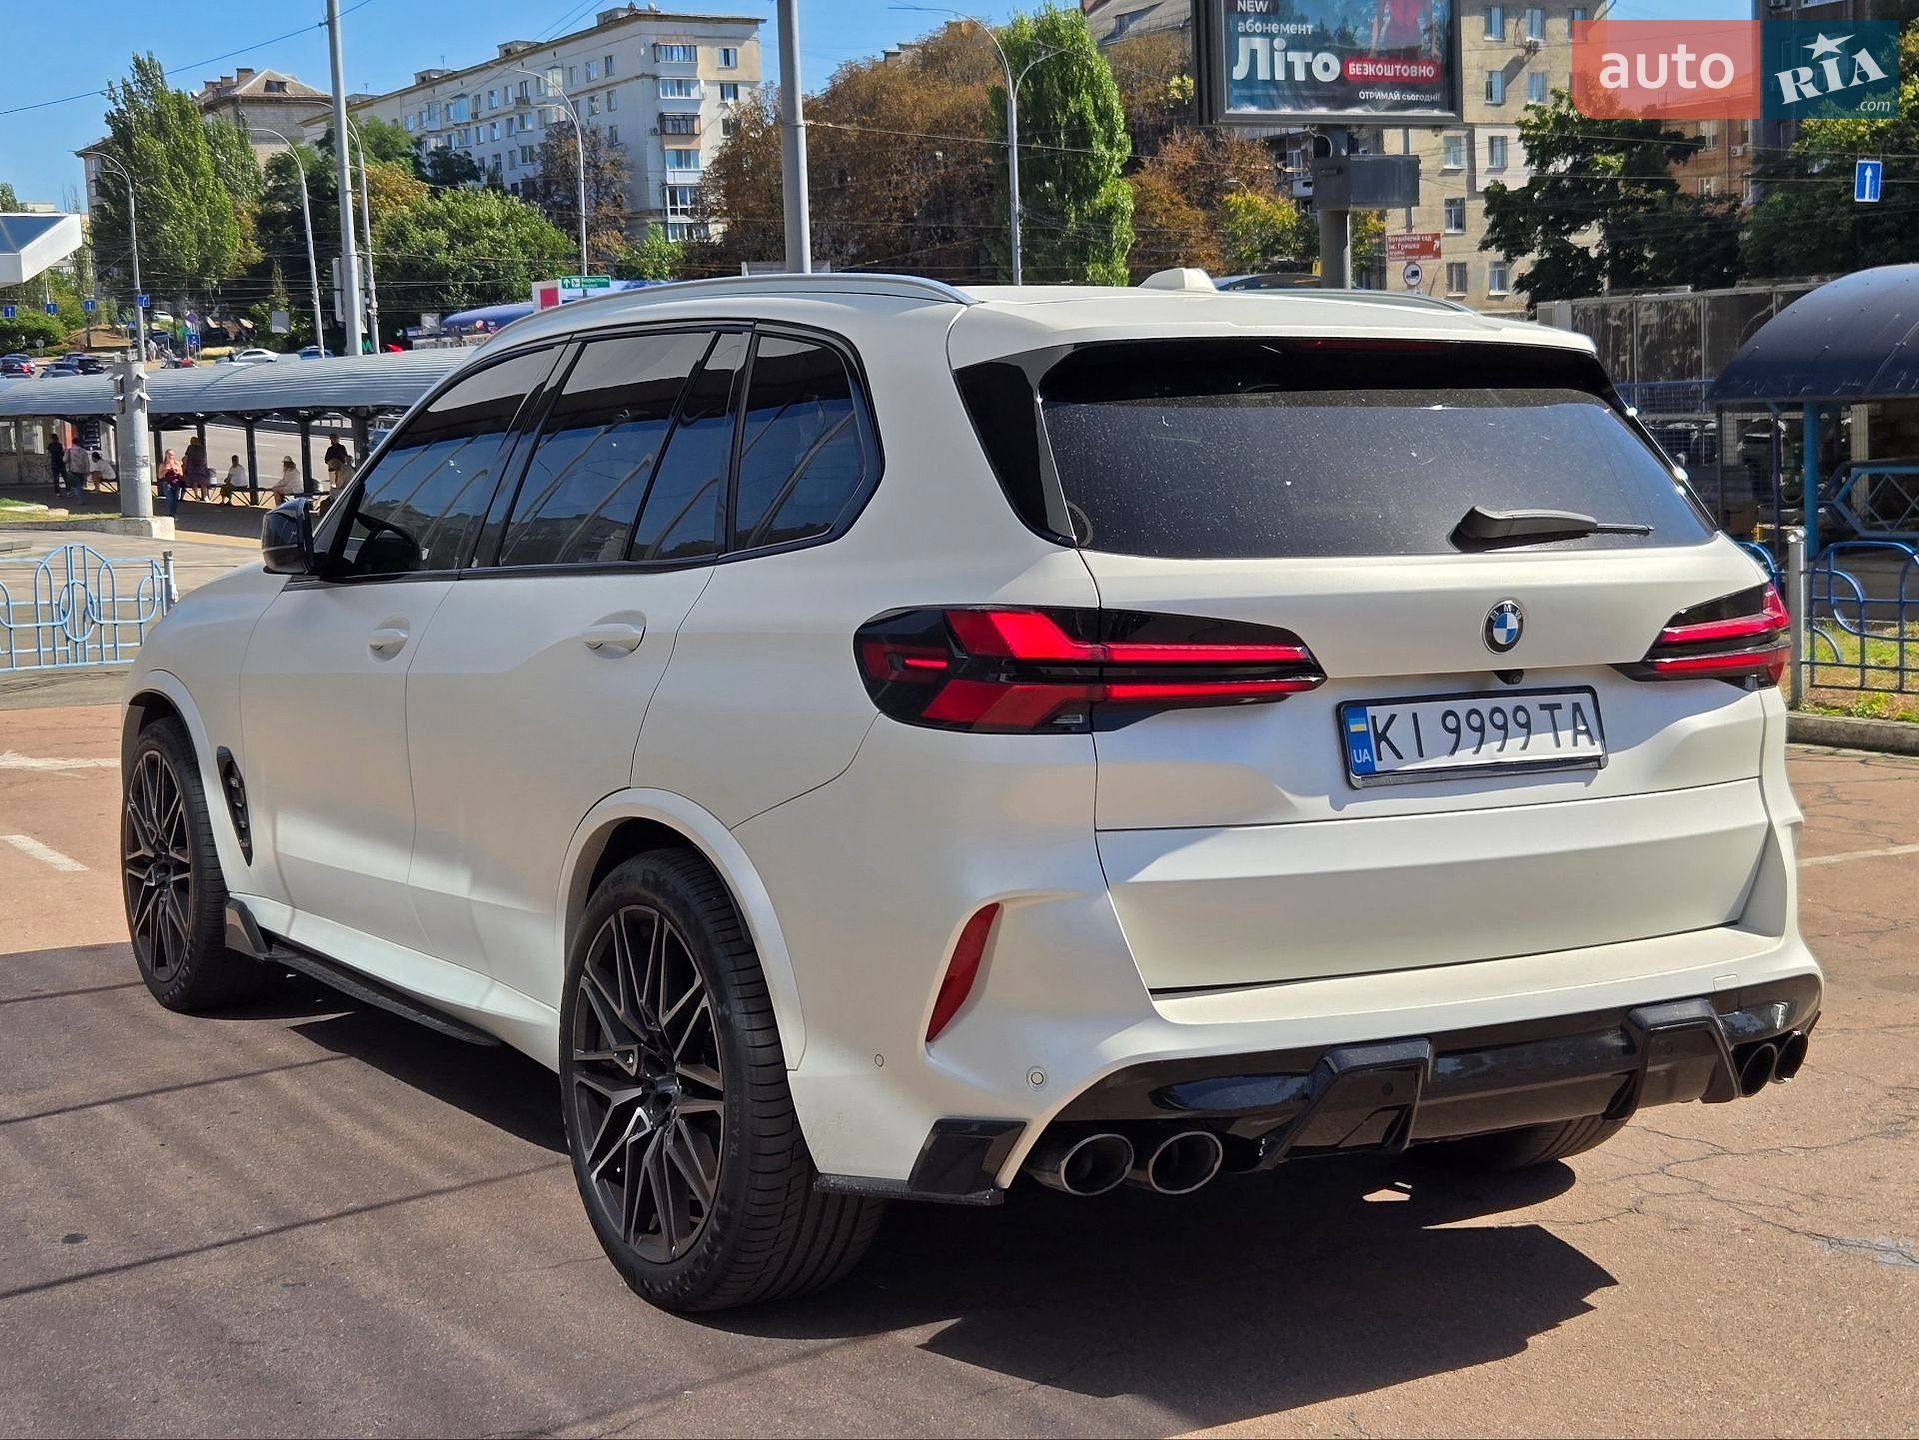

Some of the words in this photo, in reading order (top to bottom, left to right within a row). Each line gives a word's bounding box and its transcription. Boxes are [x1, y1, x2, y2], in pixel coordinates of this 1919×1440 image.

[1237, 0, 1268, 12] NEW
[1237, 19, 1313, 35] абонемент
[1232, 37, 1341, 82] Літо
[1348, 62, 1435, 78] БЕЗКОШТОВНО
[1358, 90, 1400, 101] ОТРИМАЙ
[1402, 92, 1440, 102] сьогодні!
[1370, 712, 1425, 761] KI
[1441, 704, 1532, 756] 9999
[1538, 702, 1596, 748] TA
[1353, 748, 1373, 764] UA
